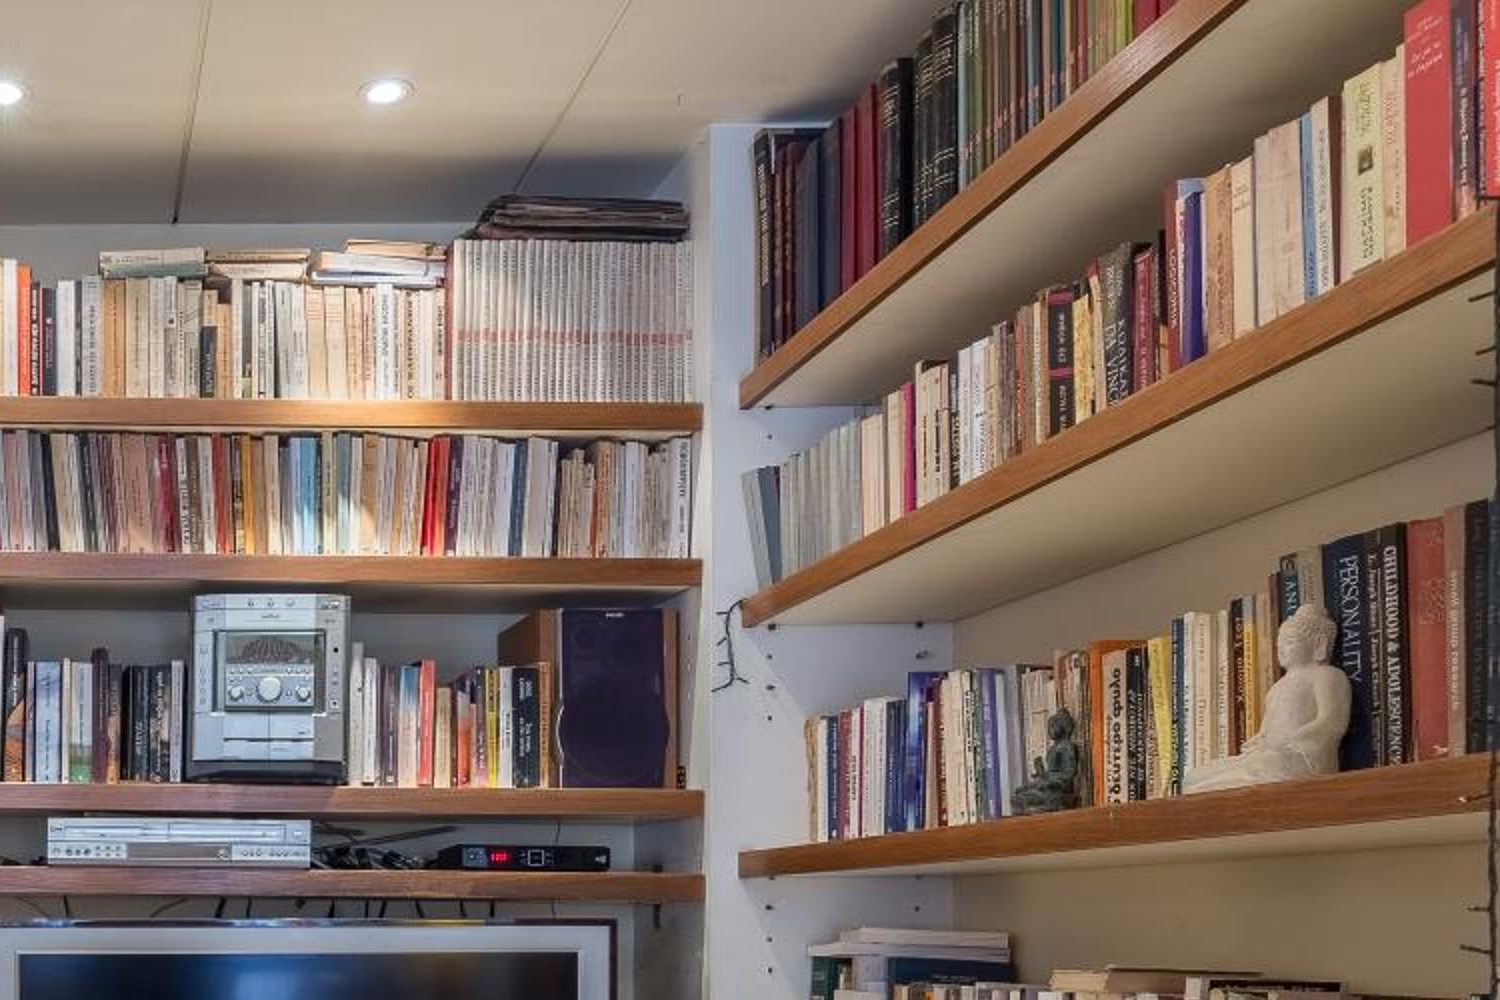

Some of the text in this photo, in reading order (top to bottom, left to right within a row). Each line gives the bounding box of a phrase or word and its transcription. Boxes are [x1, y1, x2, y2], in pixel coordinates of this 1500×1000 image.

[1339, 555, 1363, 683] PERSONALITY
[1383, 545, 1399, 638] CHILDHOOD
[1387, 641, 1398, 653] &
[1451, 651, 1460, 711] research
